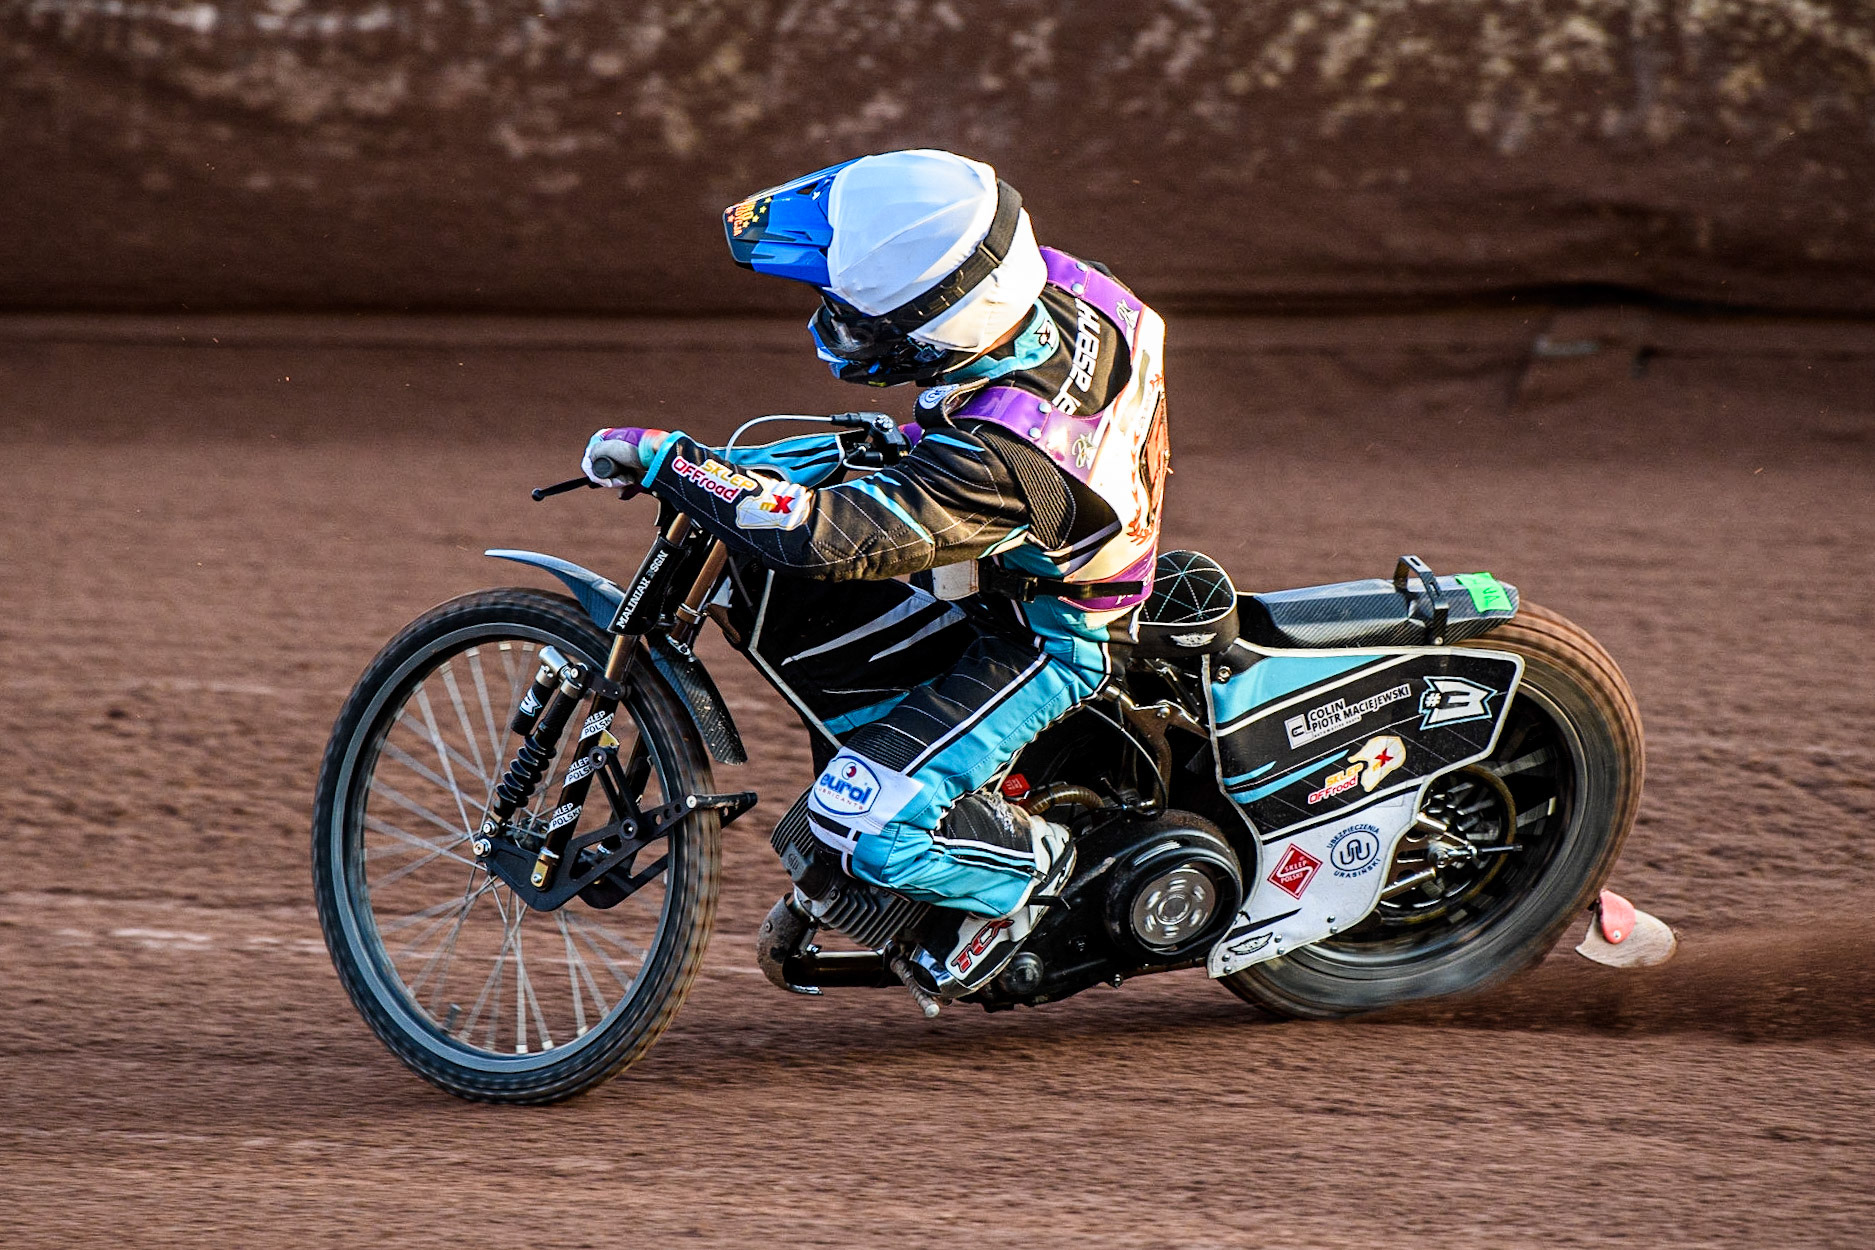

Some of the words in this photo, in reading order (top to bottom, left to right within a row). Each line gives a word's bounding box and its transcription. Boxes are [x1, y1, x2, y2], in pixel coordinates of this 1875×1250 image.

[702, 460, 757, 490] SKLEP
[616, 576, 652, 630] MALINIAK
[1309, 700, 1345, 721] COLIN
[1311, 714, 1341, 732] PIOTR
[1343, 685, 1410, 720] MACIEJEWSKI
[819, 772, 873, 805] eurol
[1325, 764, 1363, 787] SKLEP
[1326, 823, 1380, 849] UBEZPIECZENIA
[1280, 872, 1304, 884] POLSKI
[1284, 859, 1308, 872] SKLEP
